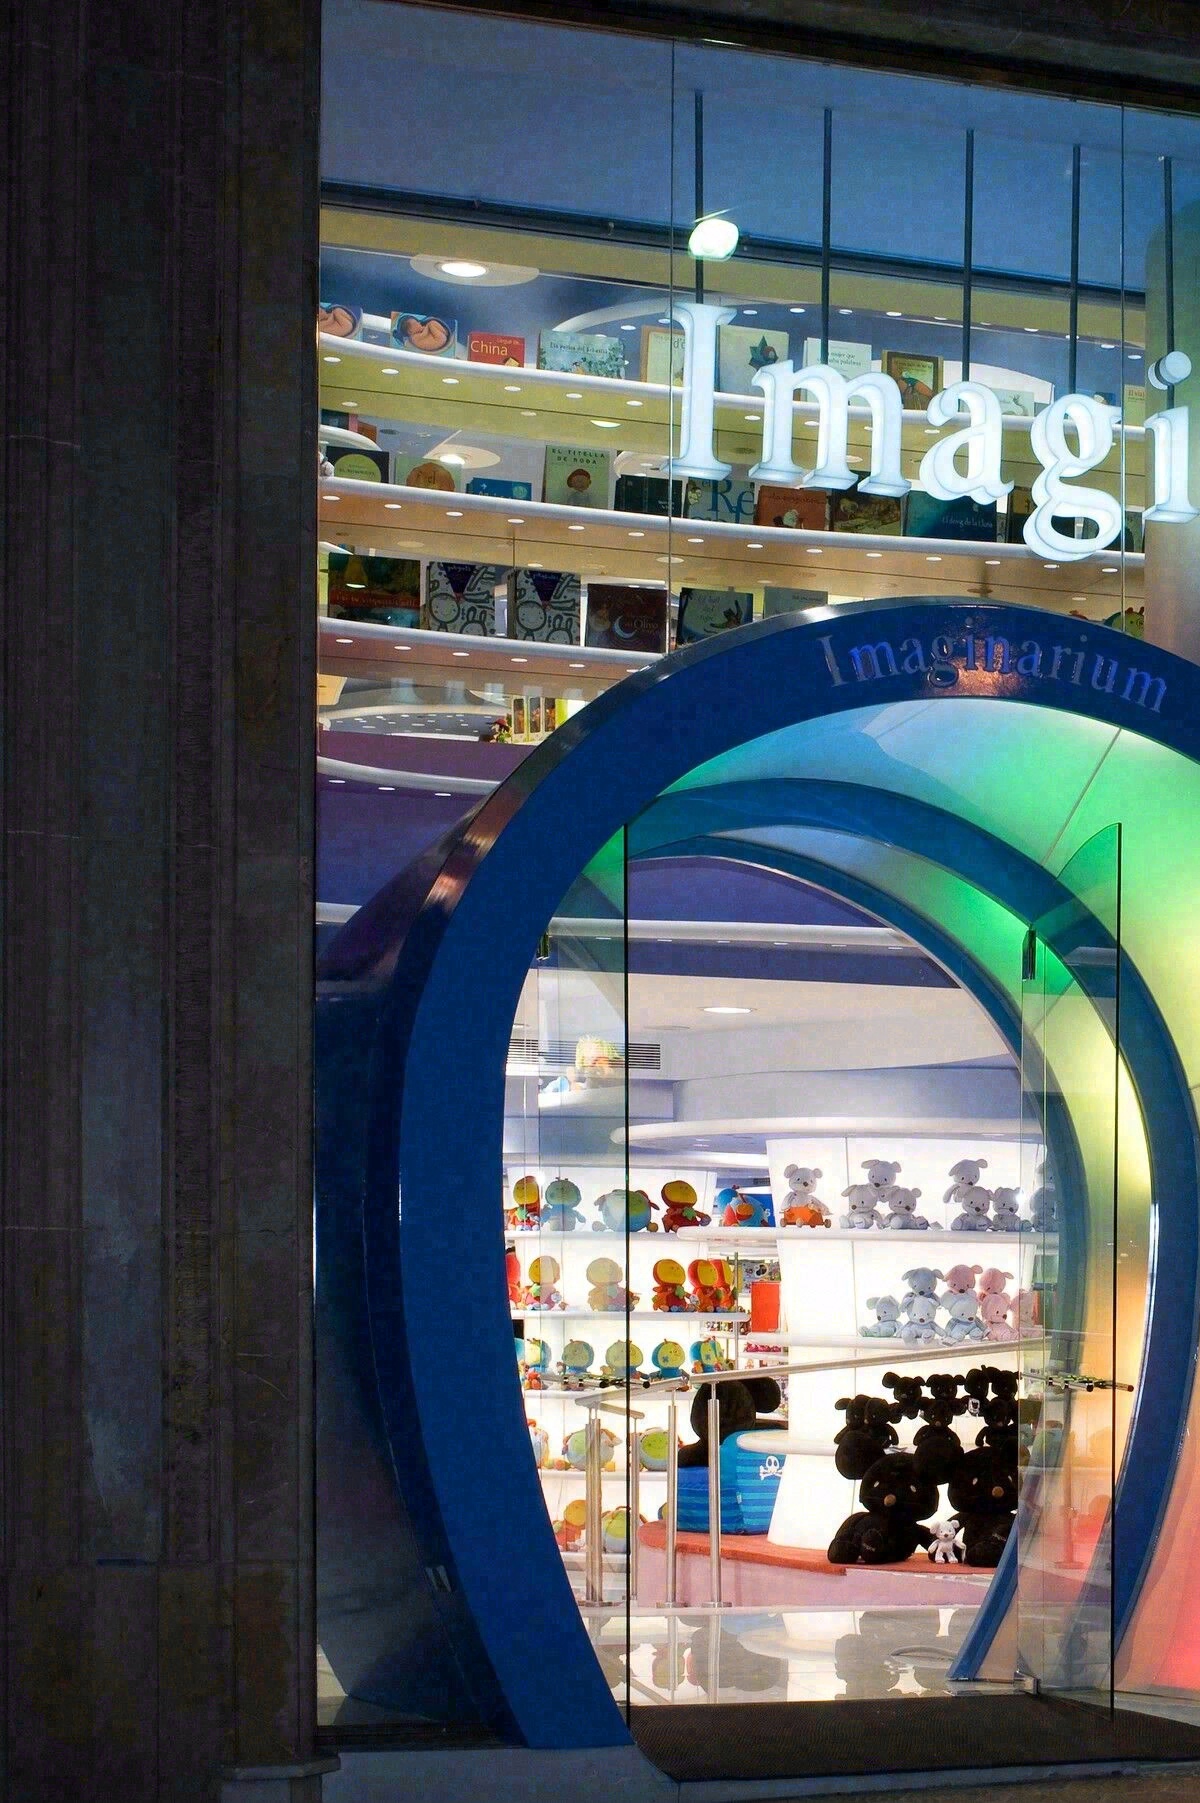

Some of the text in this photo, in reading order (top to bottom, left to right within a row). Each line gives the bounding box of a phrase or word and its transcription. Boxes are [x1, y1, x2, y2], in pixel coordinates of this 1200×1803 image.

[470, 340, 508, 356] China
[567, 449, 606, 459] TITELLA
[816, 617, 1168, 714] Imaginarium
